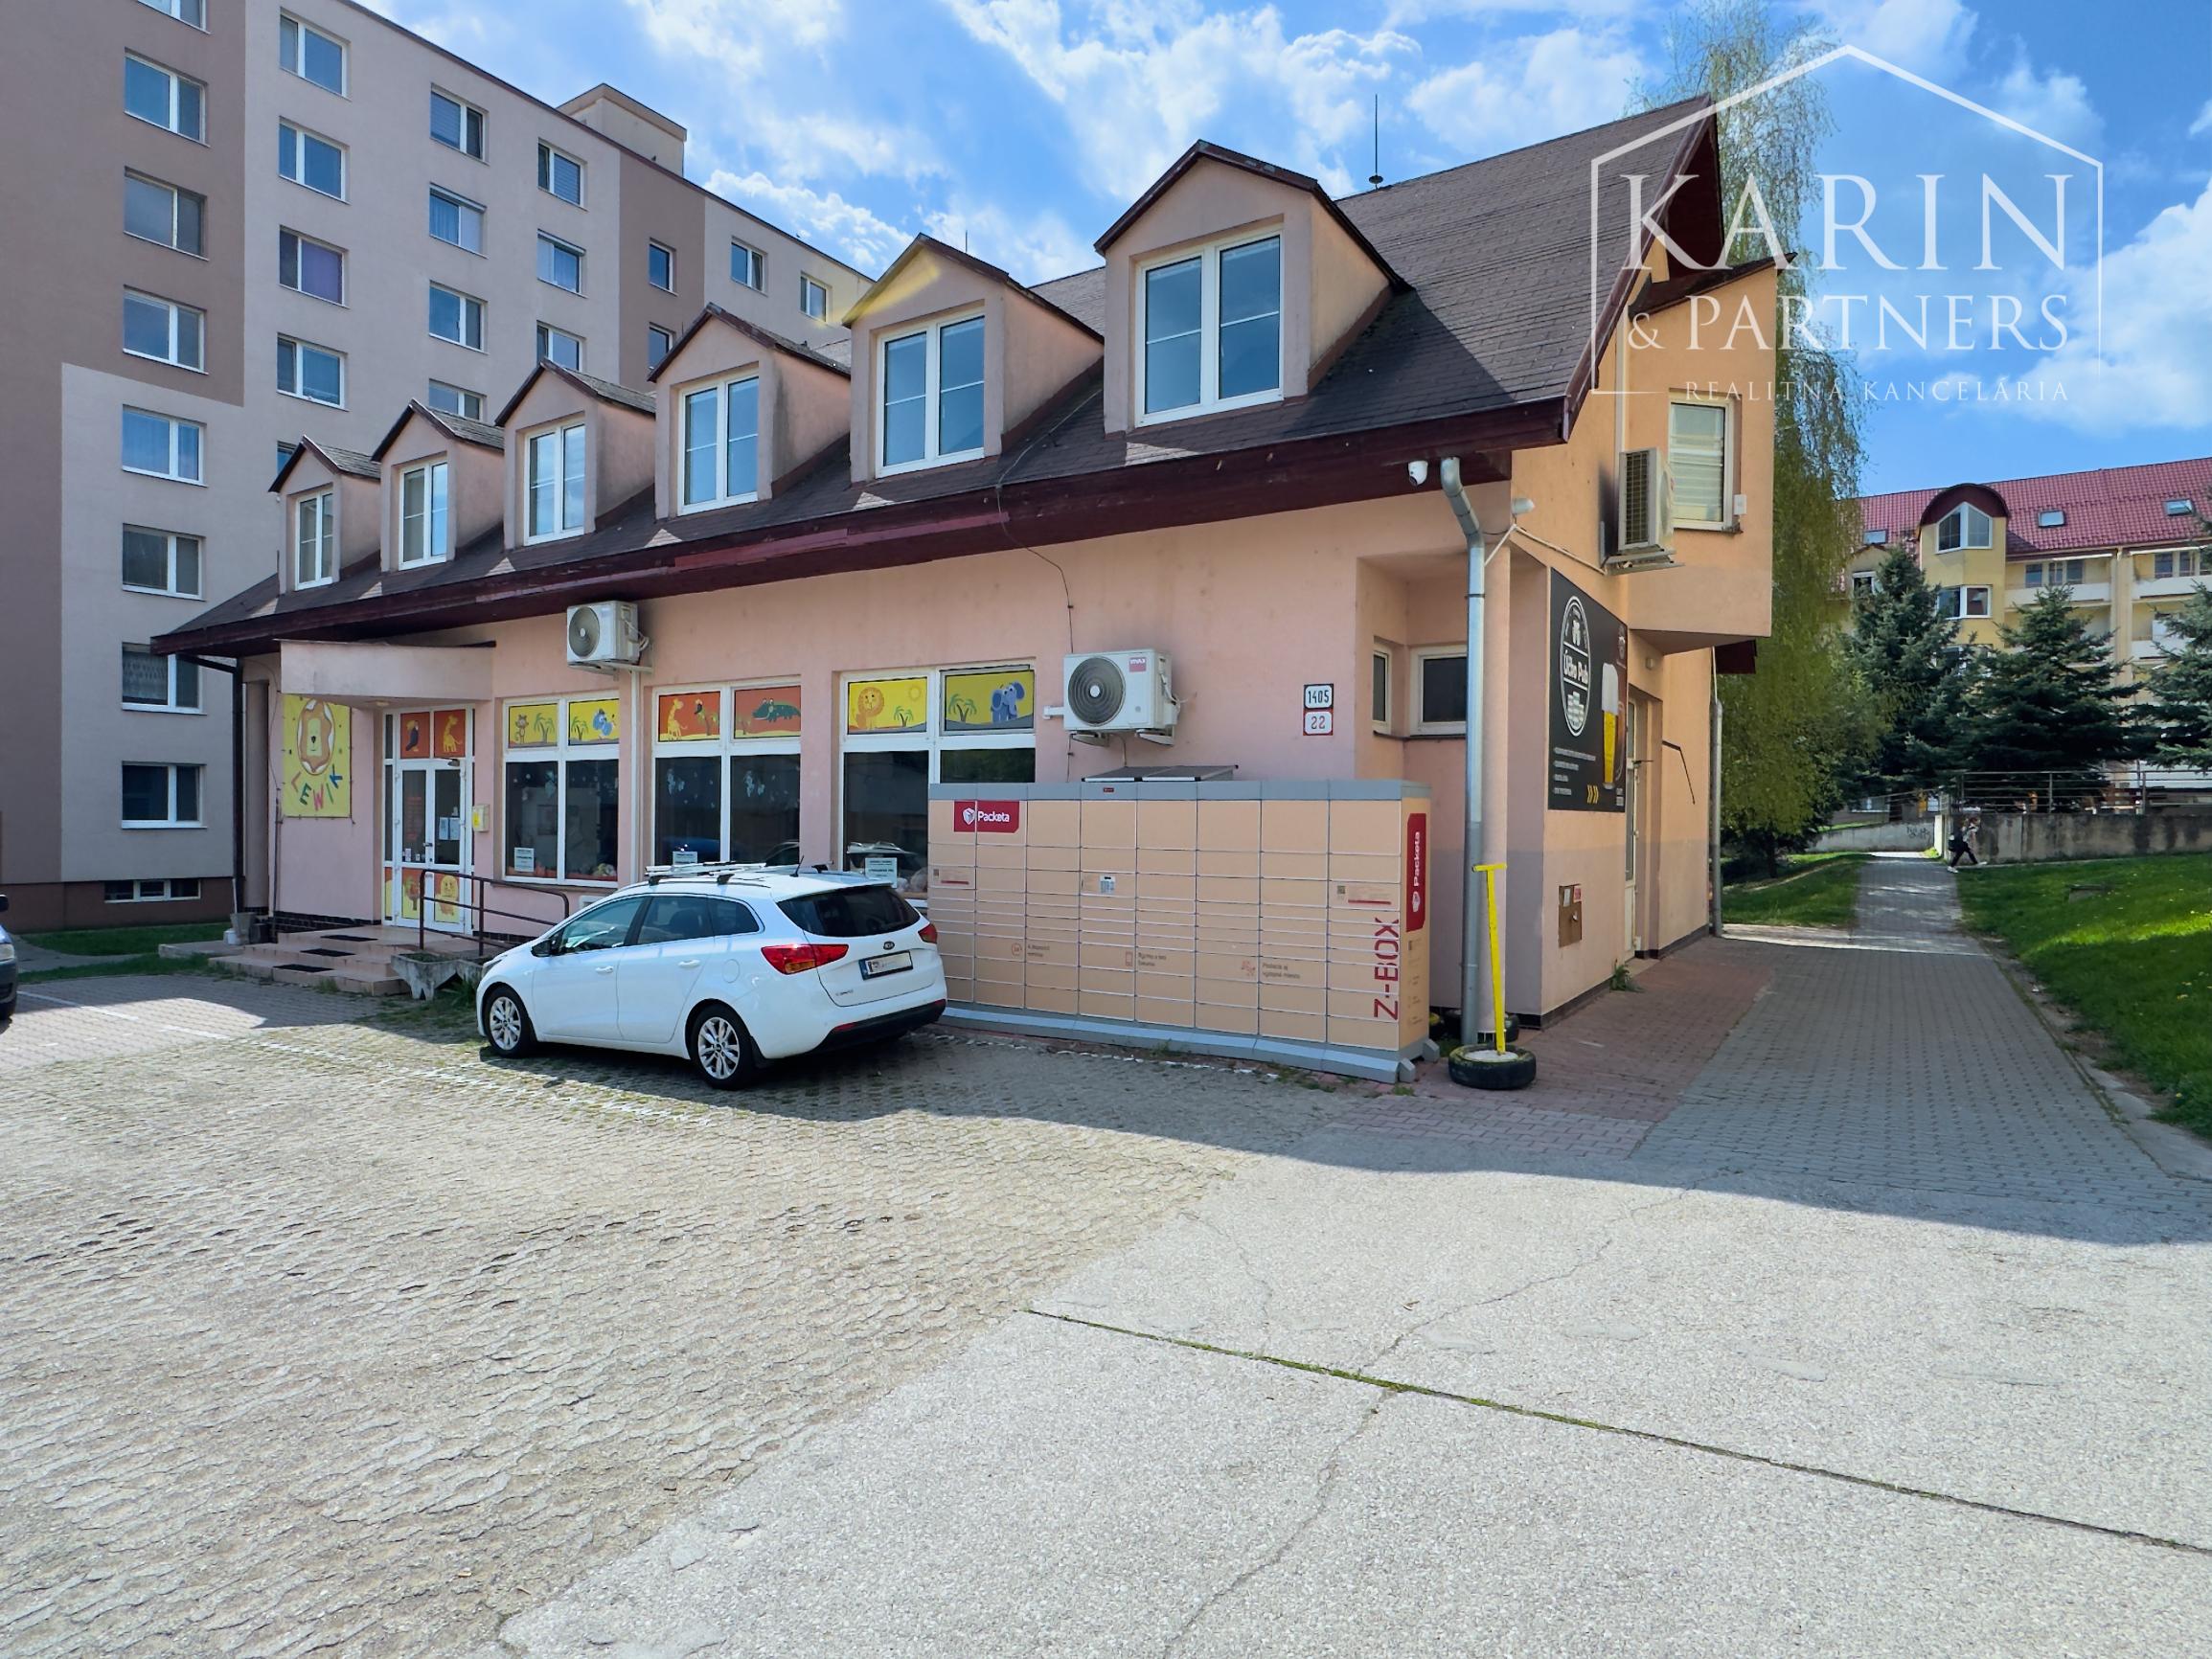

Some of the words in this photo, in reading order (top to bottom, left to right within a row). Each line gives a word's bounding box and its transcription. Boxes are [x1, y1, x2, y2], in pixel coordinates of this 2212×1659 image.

[1308, 690, 1330, 704] 1405
[1311, 716, 1326, 730] 22
[977, 810, 1011, 823] Packeta
[1374, 917, 1400, 1021] Z-BOX
